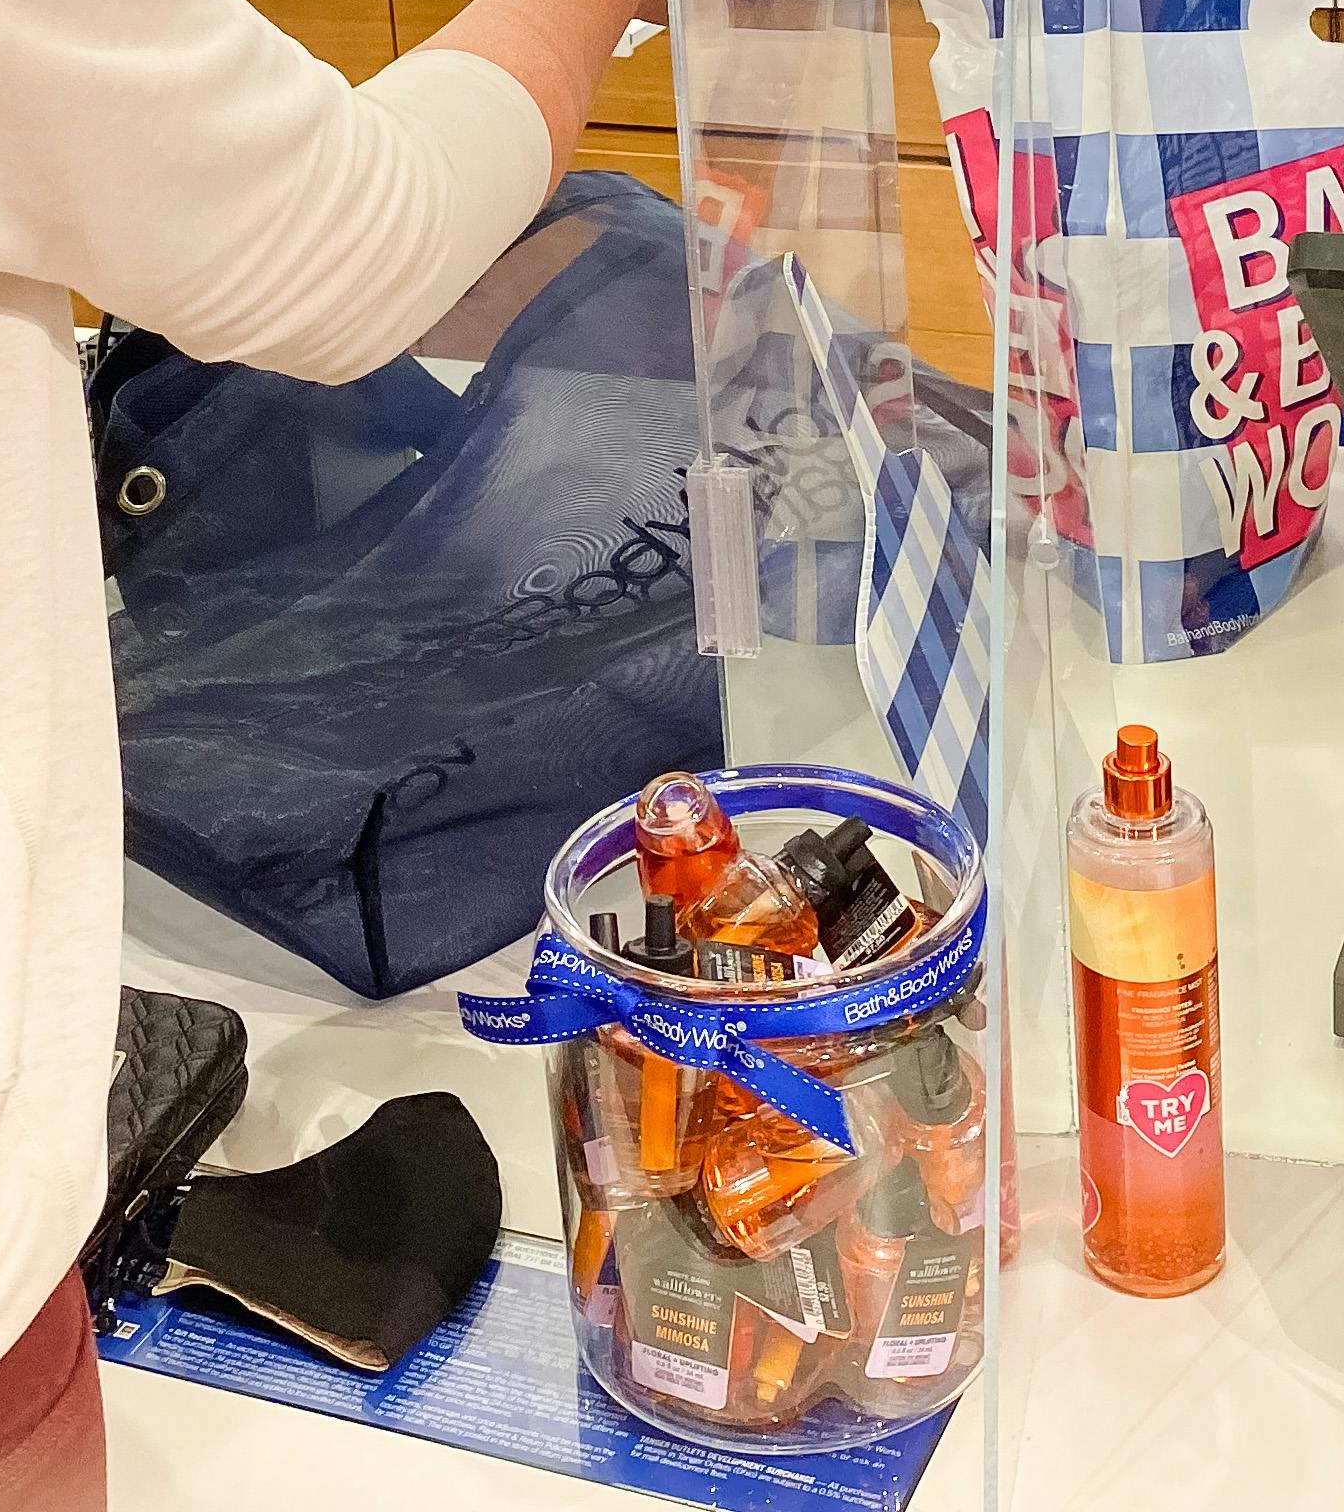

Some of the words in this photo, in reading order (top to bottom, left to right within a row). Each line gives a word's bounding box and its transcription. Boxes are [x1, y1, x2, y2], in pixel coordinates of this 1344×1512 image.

[1141, 1091, 1196, 1120] TRY
[1153, 1115, 1188, 1136] ME
[900, 1291, 954, 1309] SUNSHINE
[650, 1304, 718, 1335] SUNSHINE
[899, 1310, 945, 1327] MIMOSA
[655, 1325, 710, 1354] MIMOSA
[671, 1442, 706, 1457] OUTLETS
[706, 1451, 766, 1472] DEVELOPMENT
[765, 1465, 816, 1484] SURCHARGE
